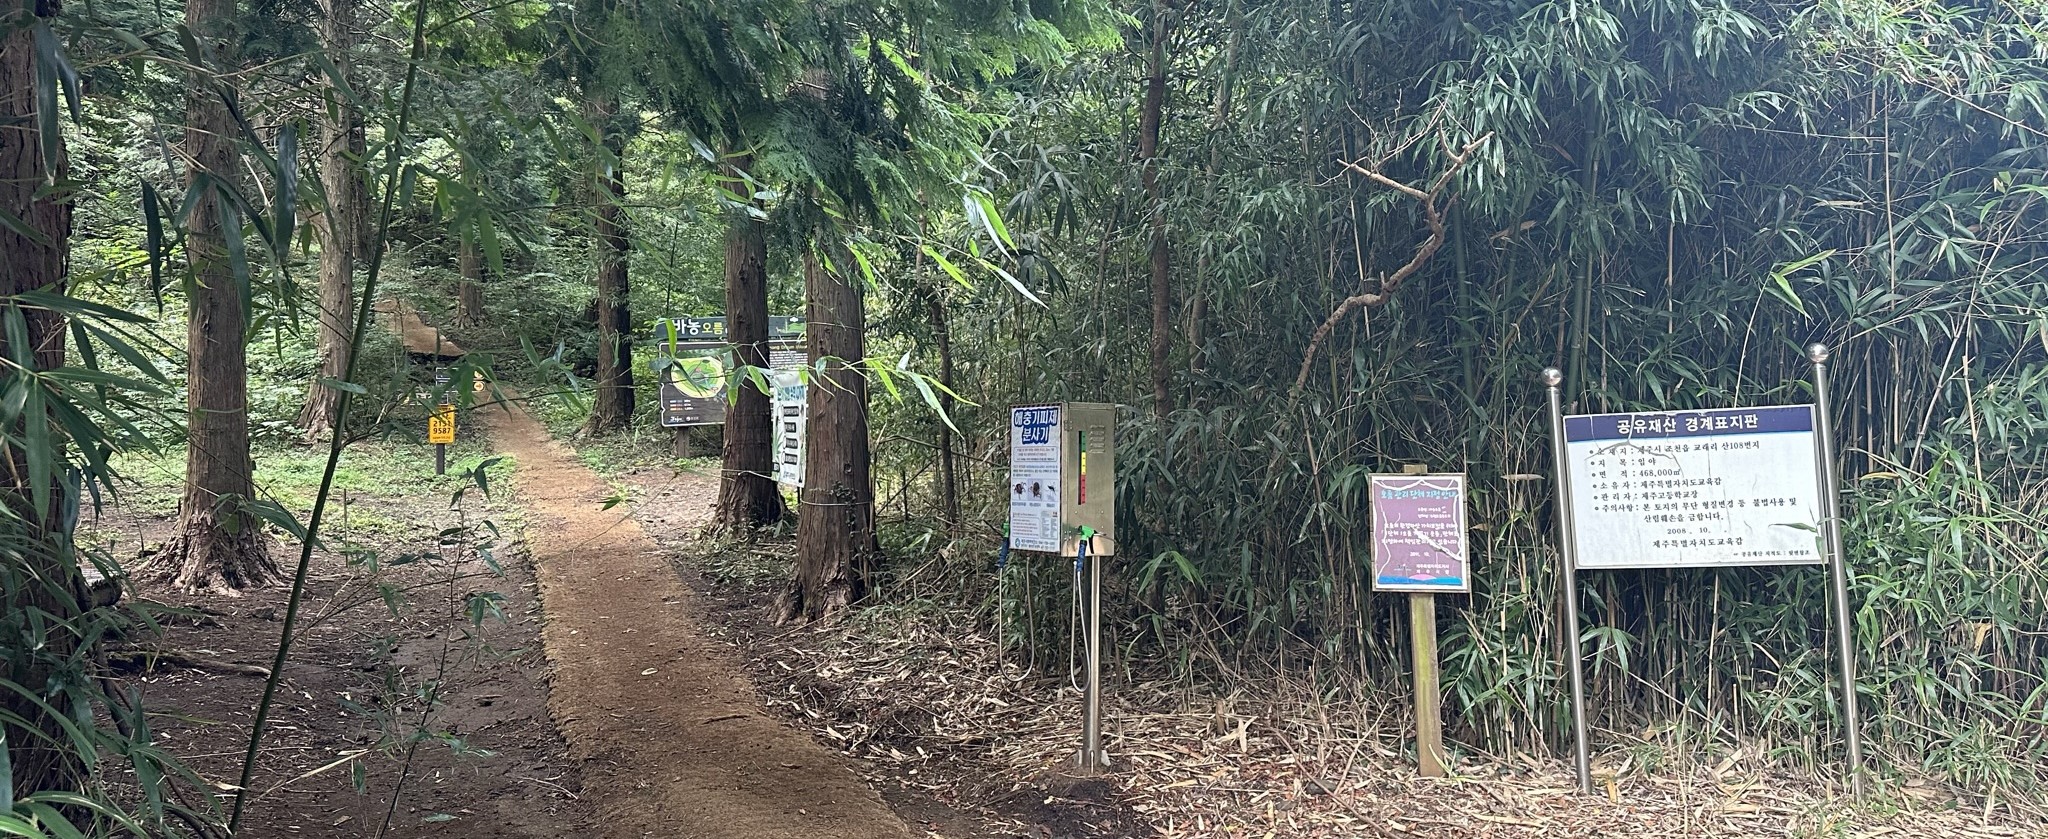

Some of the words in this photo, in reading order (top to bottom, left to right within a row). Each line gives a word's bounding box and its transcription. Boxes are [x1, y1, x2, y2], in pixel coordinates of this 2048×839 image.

[1014, 409, 1058, 426] 해충기피제
[1617, 416, 1676, 434] 공유재산
[1686, 414, 1758, 432] 경계표지판
[1022, 426, 1048, 442] 분사기
[1694, 442, 1718, 452] 교래리
[1722, 440, 1760, 450] 산108번지
[1640, 477, 1722, 488] 제주특별자치도교육감
[1642, 490, 1698, 500] 제주고등학교장
[1643, 504, 1650, 512] 본
[1654, 502, 1678, 511] 토지의
[1682, 502, 1698, 510] 무단
[1702, 500, 1734, 509] 형질변경
[1738, 499, 1746, 508] 등
[1752, 498, 1784, 507] 불법사용
[1789, 498, 1796, 506] 및
[1688, 512, 1724, 522] 금합니다.
[1652, 536, 1744, 548] 제주특별자치도교육감
